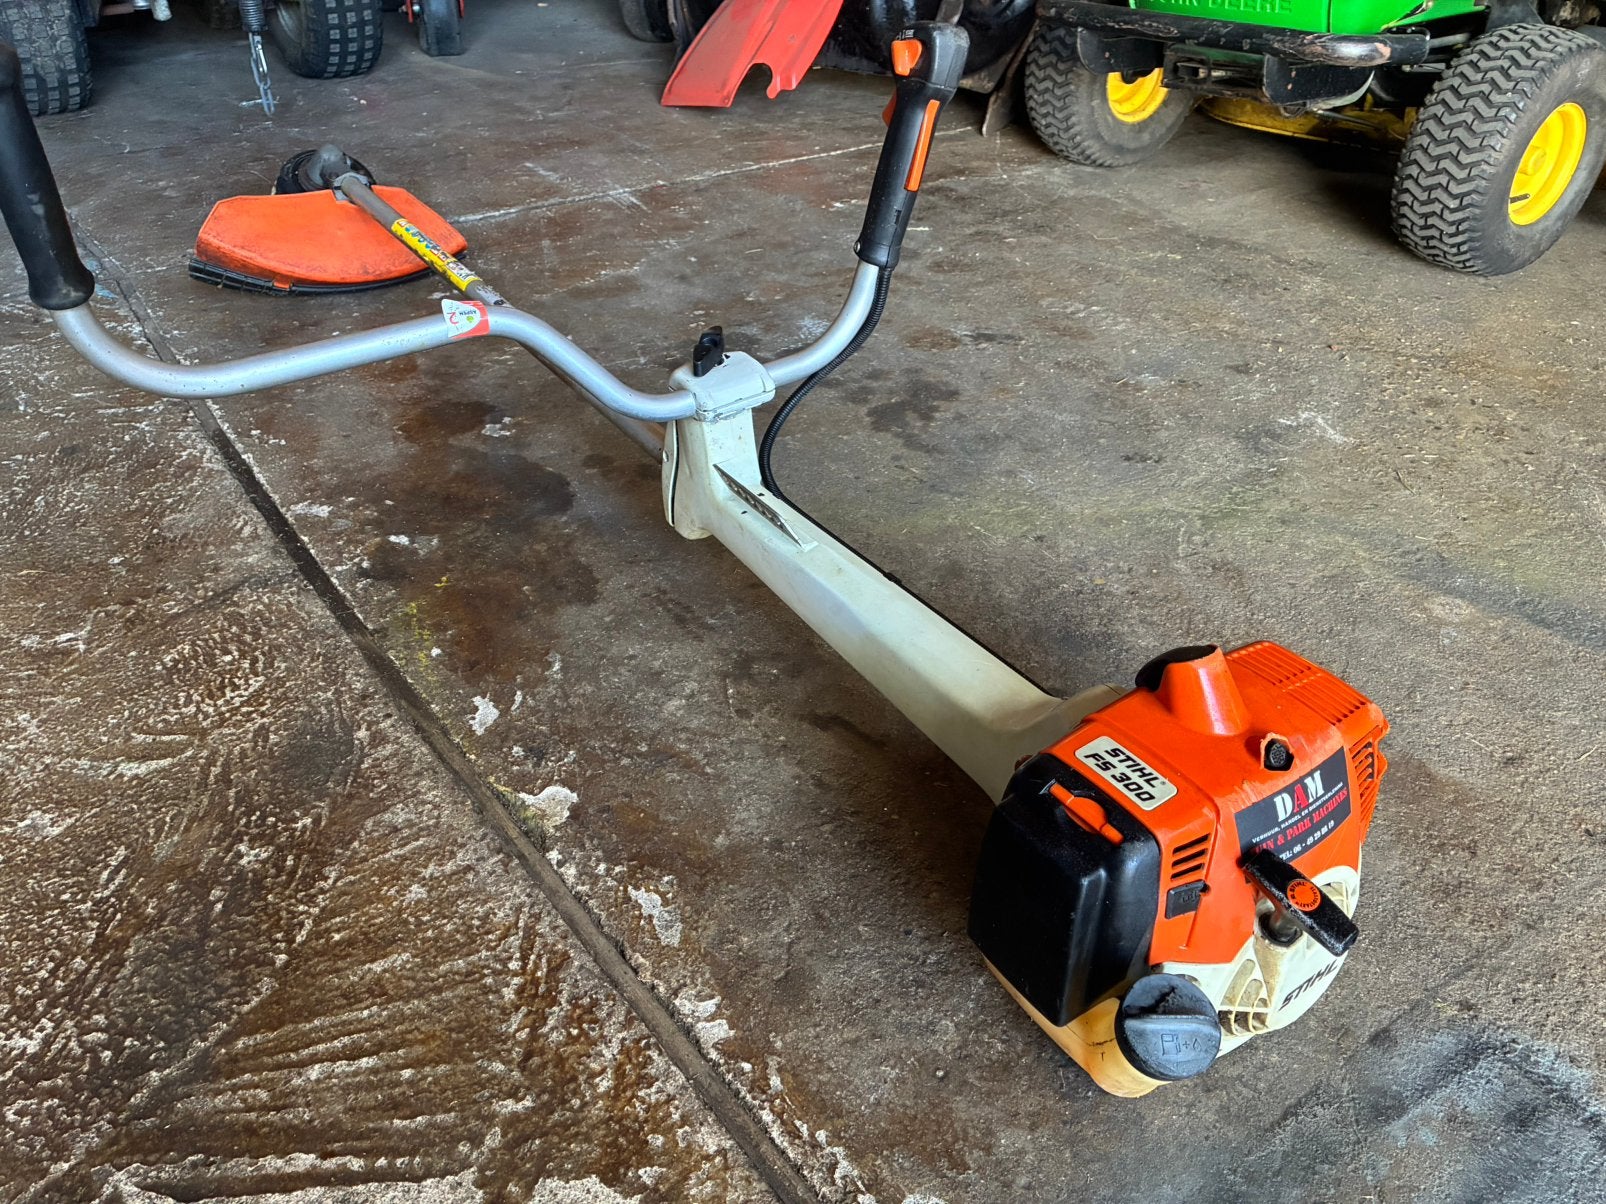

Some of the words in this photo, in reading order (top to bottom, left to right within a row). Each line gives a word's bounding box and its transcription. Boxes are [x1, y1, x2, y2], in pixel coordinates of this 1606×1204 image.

[447, 312, 460, 325] 2
[1084, 753, 1117, 771] FS
[1111, 773, 1155, 801] 300
[1104, 748, 1159, 788] STIHL
[1274, 770, 1324, 822] DAM
[1277, 834, 1285, 846] &
[1286, 817, 1312, 840] PARK
[1312, 787, 1348, 823] MACHINES
[1281, 815, 1301, 829] HANDEL
[1293, 843, 1302, 854] 06
[1328, 820, 1335, 829] 19
[1279, 959, 1338, 1011] STIHL
